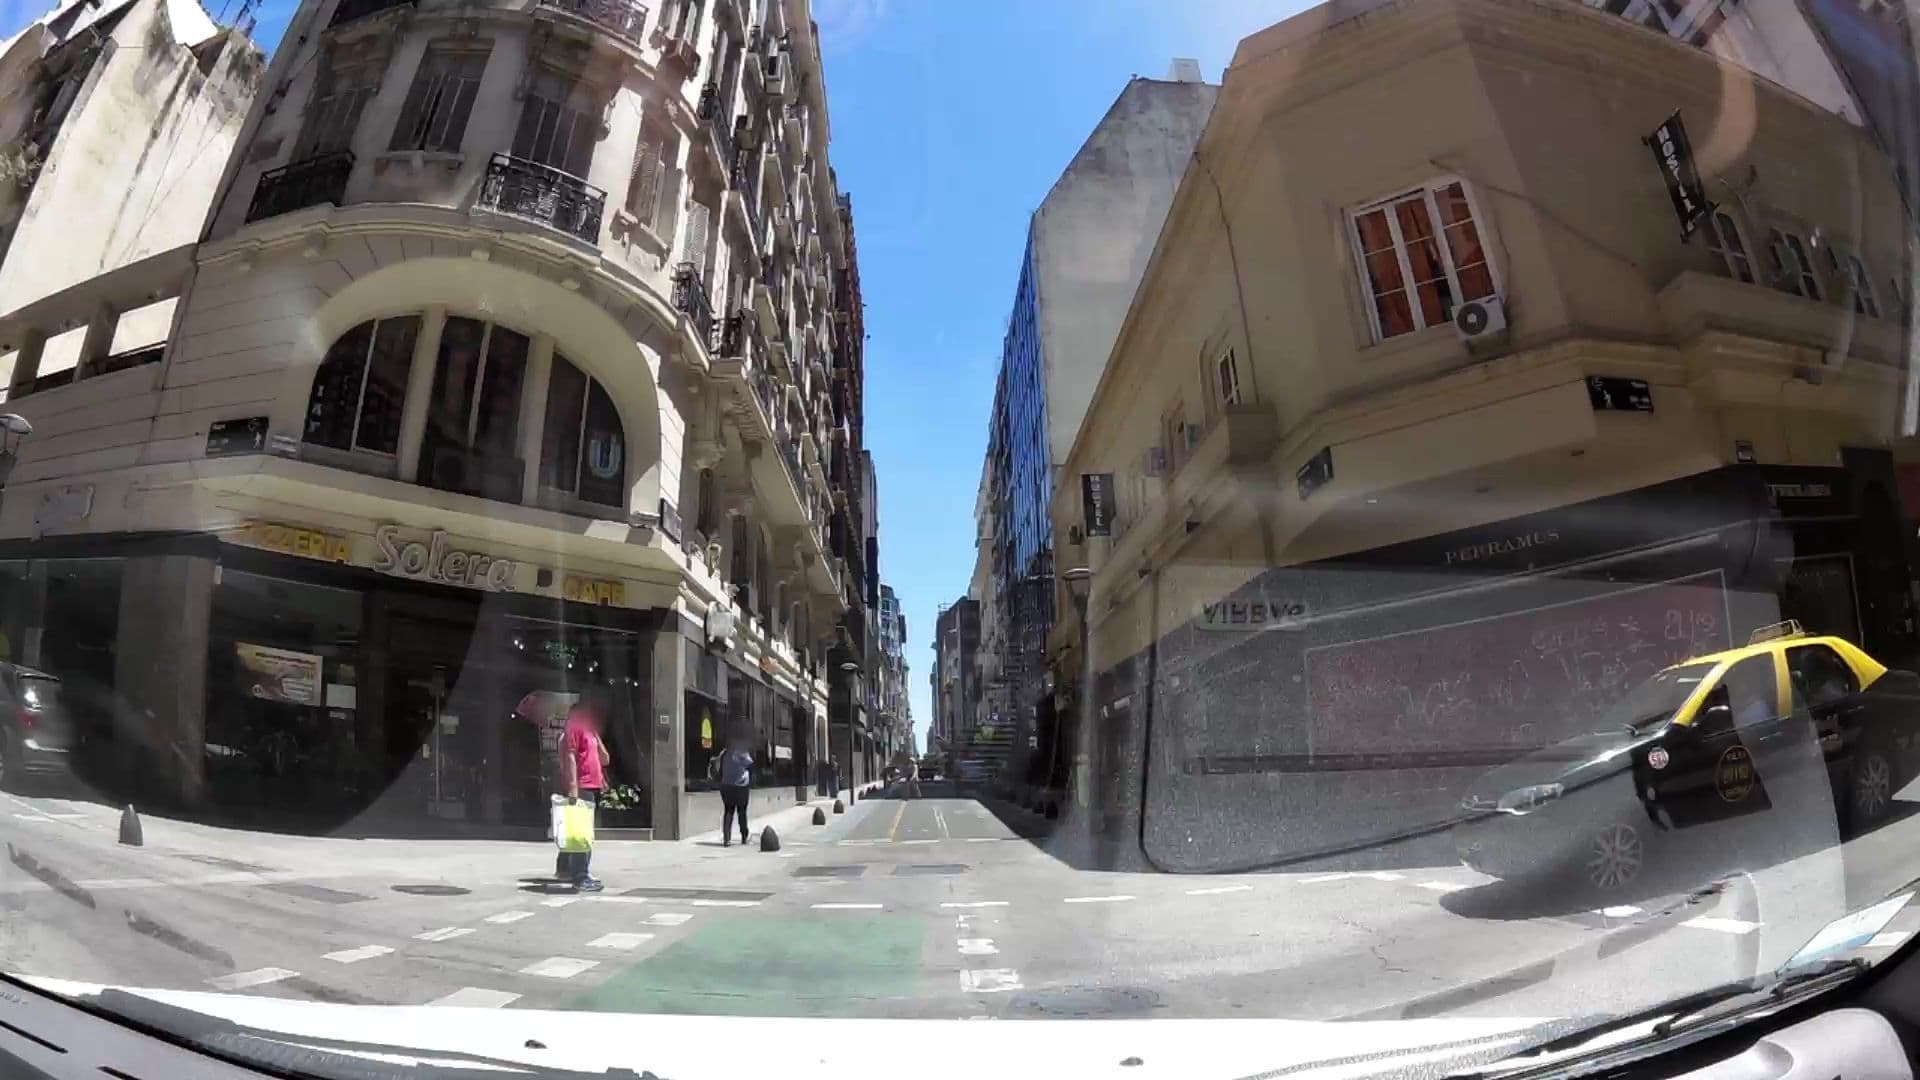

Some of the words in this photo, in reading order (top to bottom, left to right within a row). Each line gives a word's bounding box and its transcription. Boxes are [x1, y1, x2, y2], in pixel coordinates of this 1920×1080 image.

[240, 522, 347, 561] ZZERIA
[374, 525, 520, 592] Solera
[1444, 530, 1560, 563] PERRAMUS
